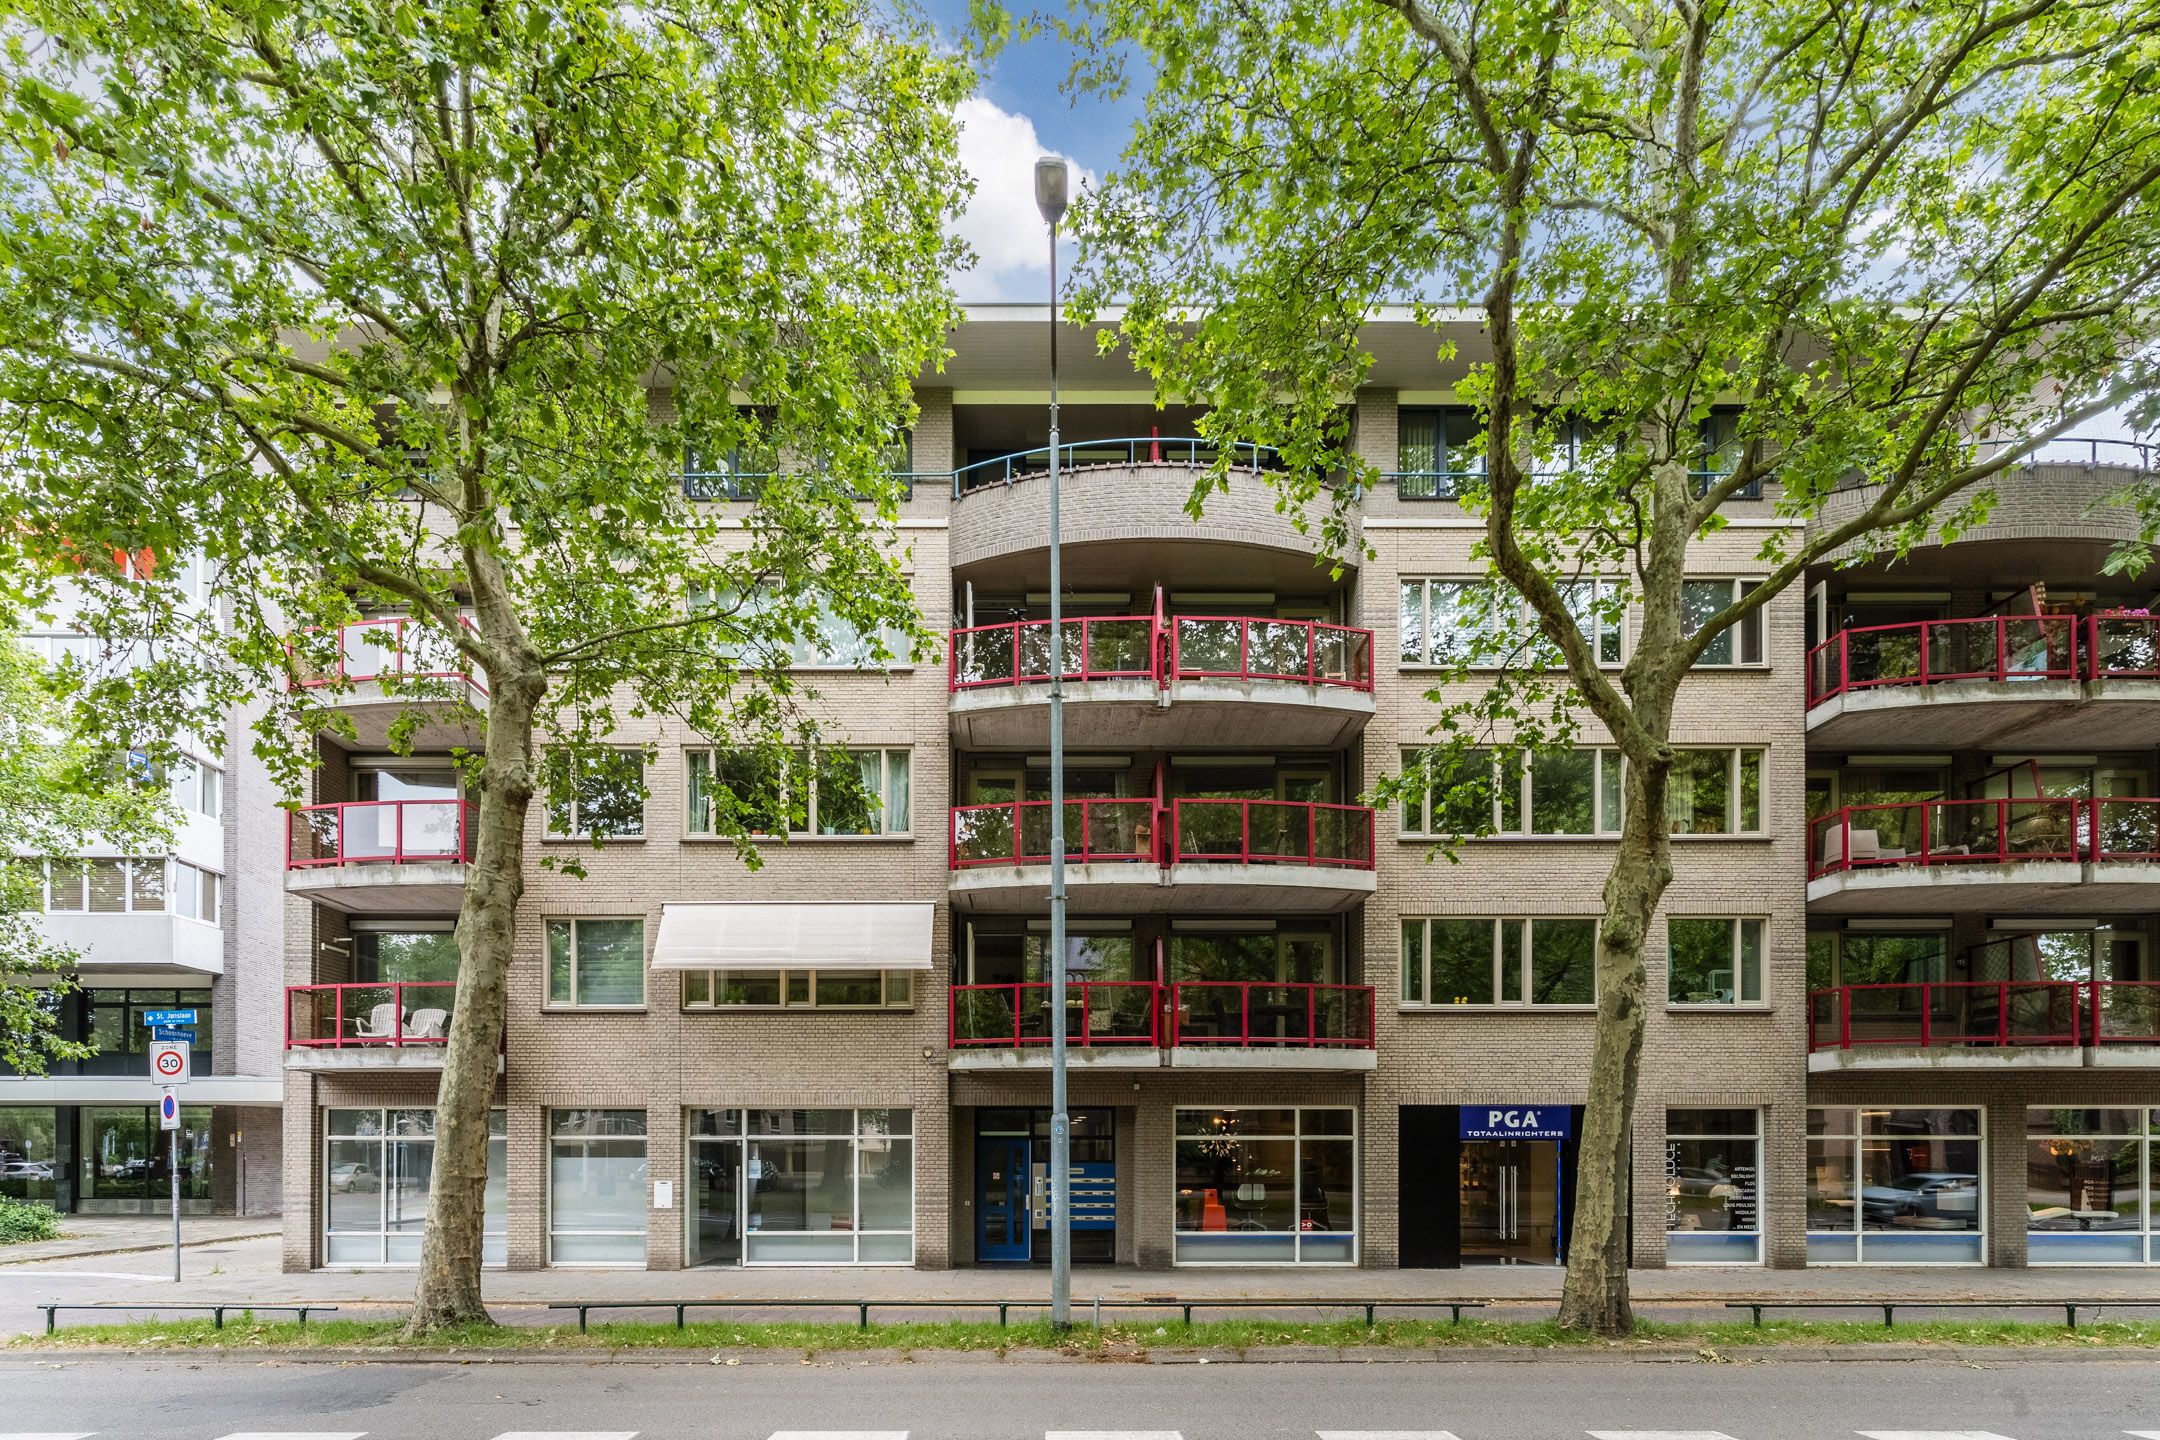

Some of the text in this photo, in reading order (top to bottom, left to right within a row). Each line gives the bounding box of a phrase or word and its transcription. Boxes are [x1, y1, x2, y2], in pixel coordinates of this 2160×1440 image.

[156, 1012, 165, 1020] St.
[162, 1059, 178, 1068] 30
[1488, 1110, 1539, 1128] PGA
